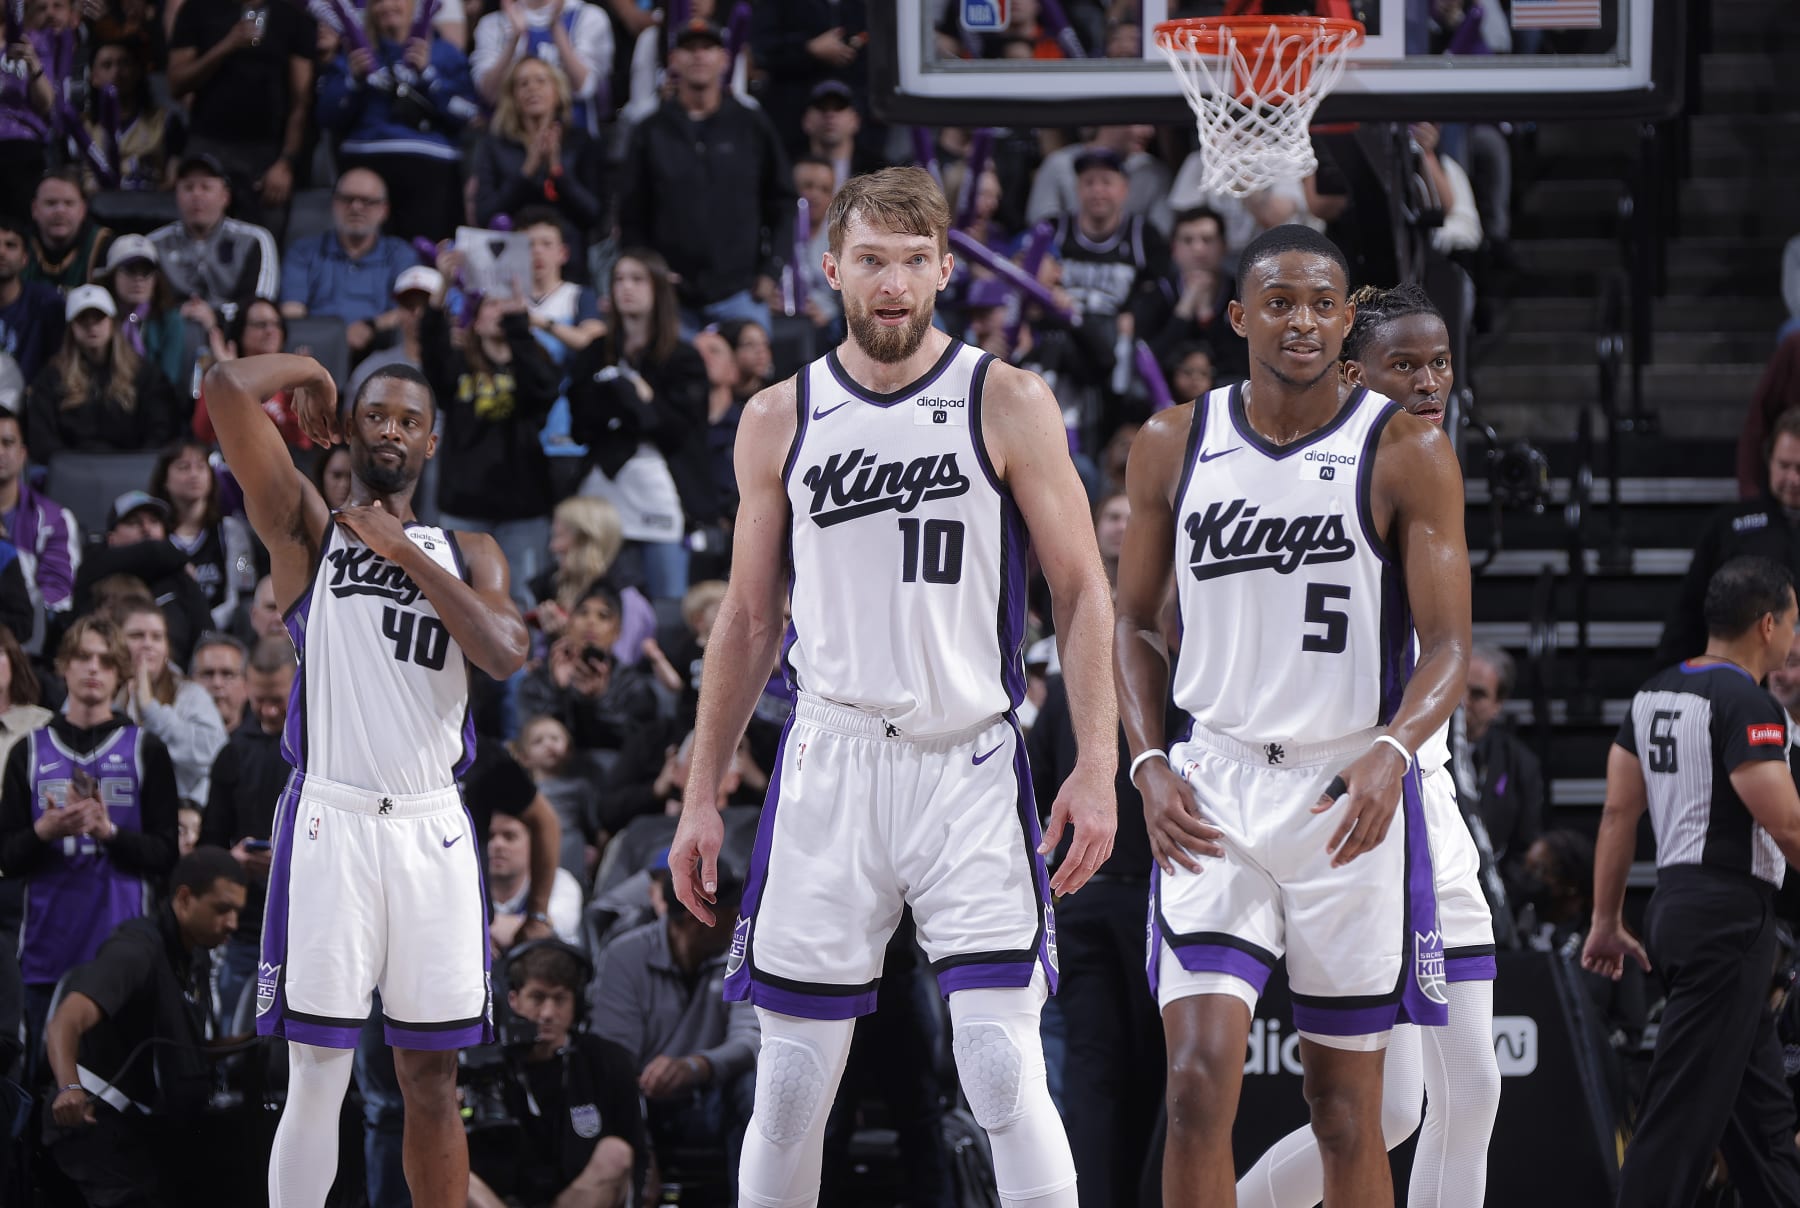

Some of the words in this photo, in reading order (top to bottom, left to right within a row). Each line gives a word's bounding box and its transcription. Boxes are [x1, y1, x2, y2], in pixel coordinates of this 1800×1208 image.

[916, 396, 965, 409] dialpad
[803, 448, 970, 528] Kings
[1304, 450, 1356, 465] dialpad
[898, 518, 965, 584] 10
[1184, 499, 1355, 581] Kings
[328, 547, 427, 606] King
[382, 605, 450, 671] 40
[1302, 582, 1351, 654] 5
